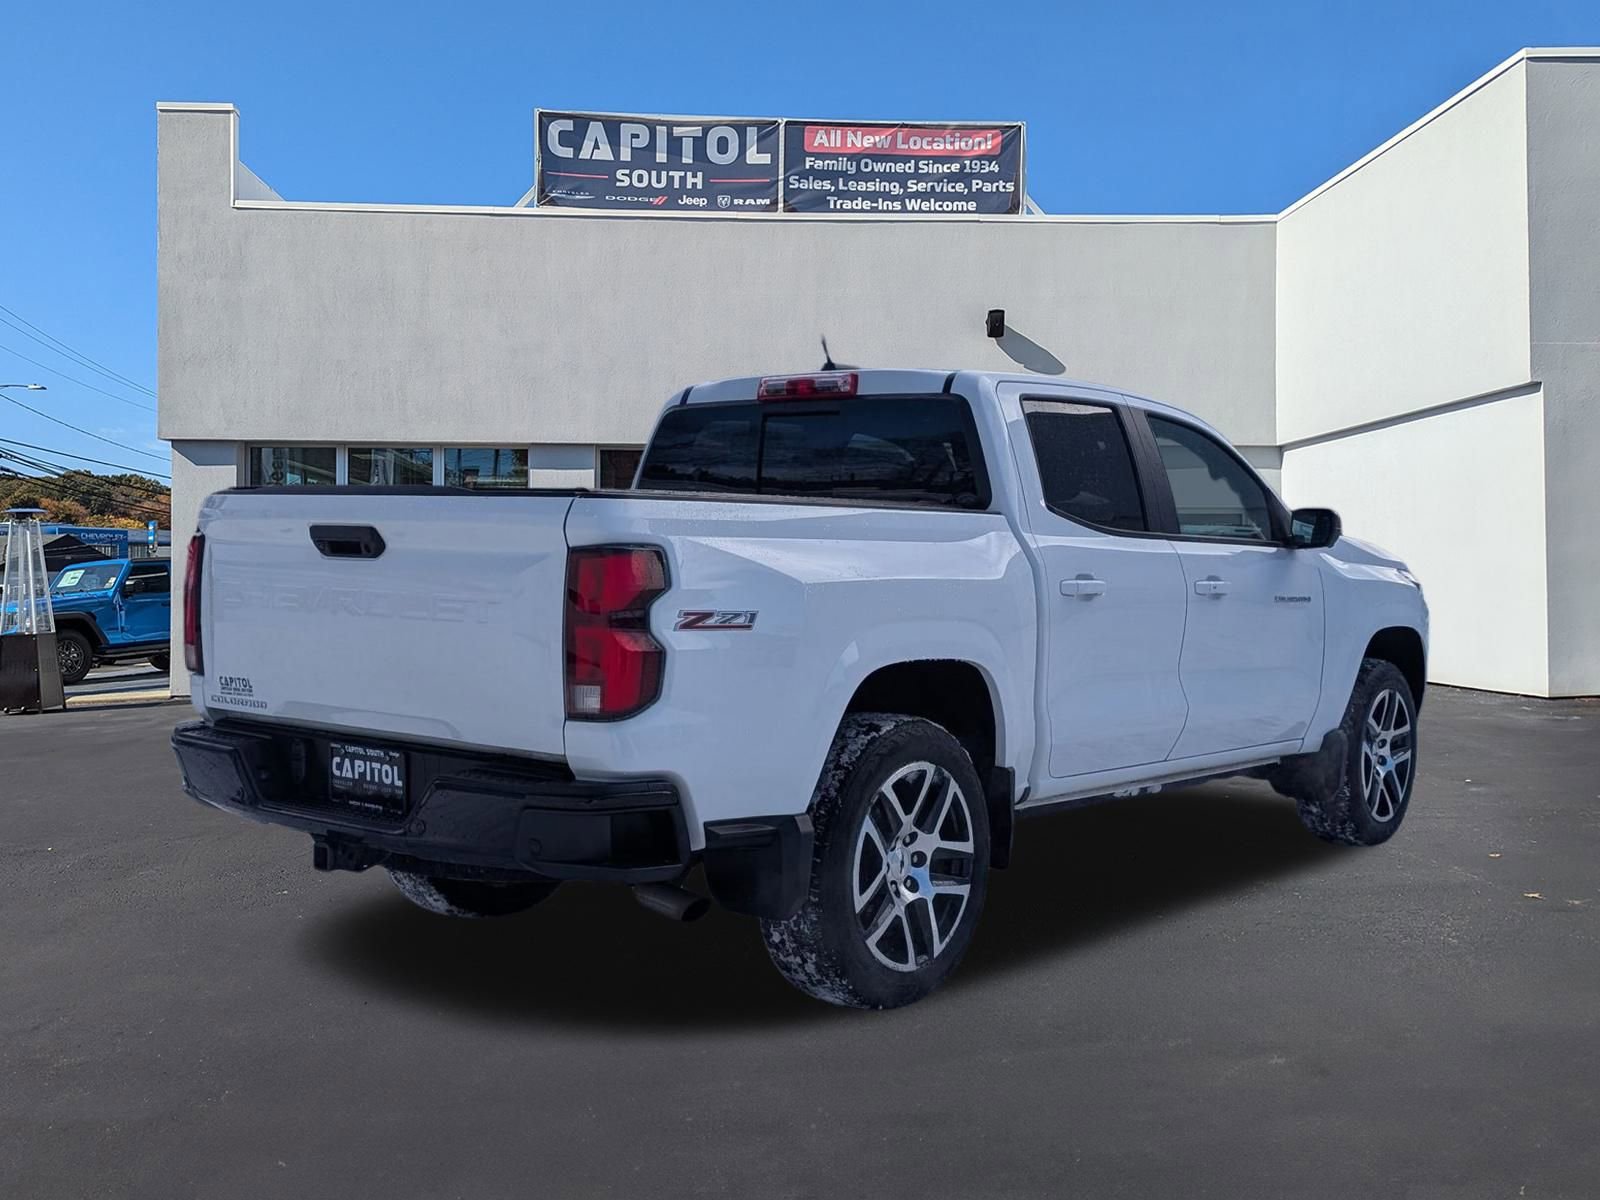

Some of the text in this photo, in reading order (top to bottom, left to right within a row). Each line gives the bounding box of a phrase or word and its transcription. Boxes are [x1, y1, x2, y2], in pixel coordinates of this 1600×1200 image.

[547, 119, 772, 165] CAPITOL
[813, 129, 993, 150] All New Location!
[805, 157, 999, 175] Family Owned Since 1934
[615, 169, 703, 190] SOUTH
[788, 176, 1015, 195] Sales, Leasing, Service, Parts
[678, 195, 708, 207] Jeep
[826, 196, 977, 212] Trade-Ins Welcome
[673, 609, 759, 632] Z71
[218, 676, 253, 689] CAPITOL
[332, 756, 403, 787] CAPITOL
